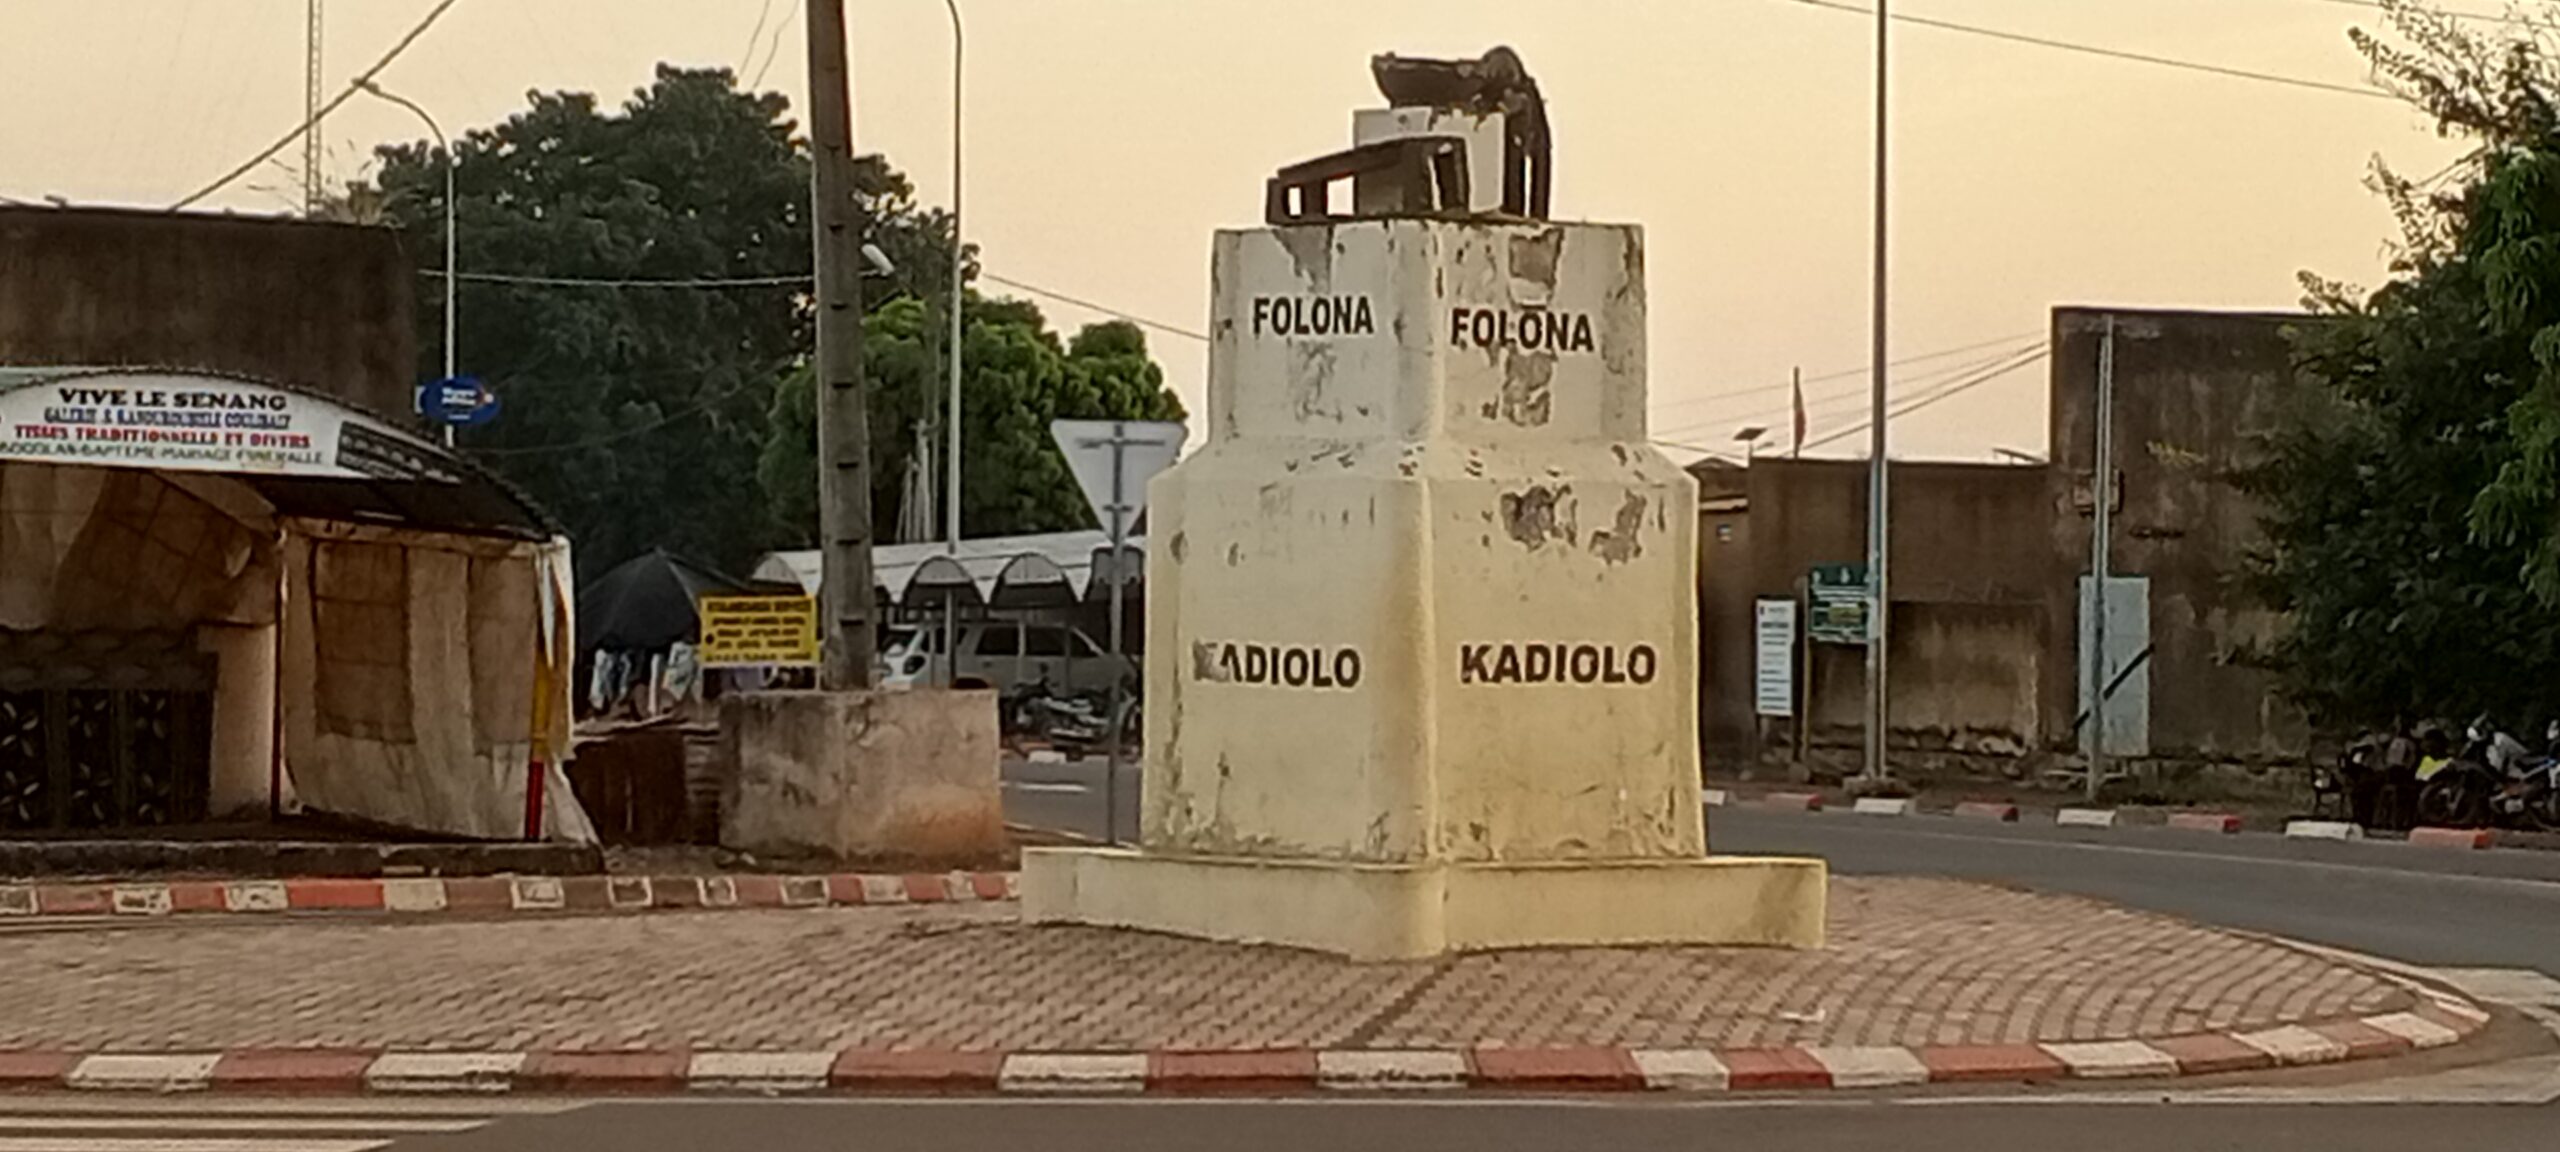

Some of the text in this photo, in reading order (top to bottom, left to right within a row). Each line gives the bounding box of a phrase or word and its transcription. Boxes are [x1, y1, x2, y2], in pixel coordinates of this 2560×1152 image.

[1253, 295, 1374, 336] FOLONA
[1450, 307, 1594, 352] FOLONA
[59, 387, 287, 411] VIVE LE SENANG
[1461, 643, 1657, 685] KADIOLO
